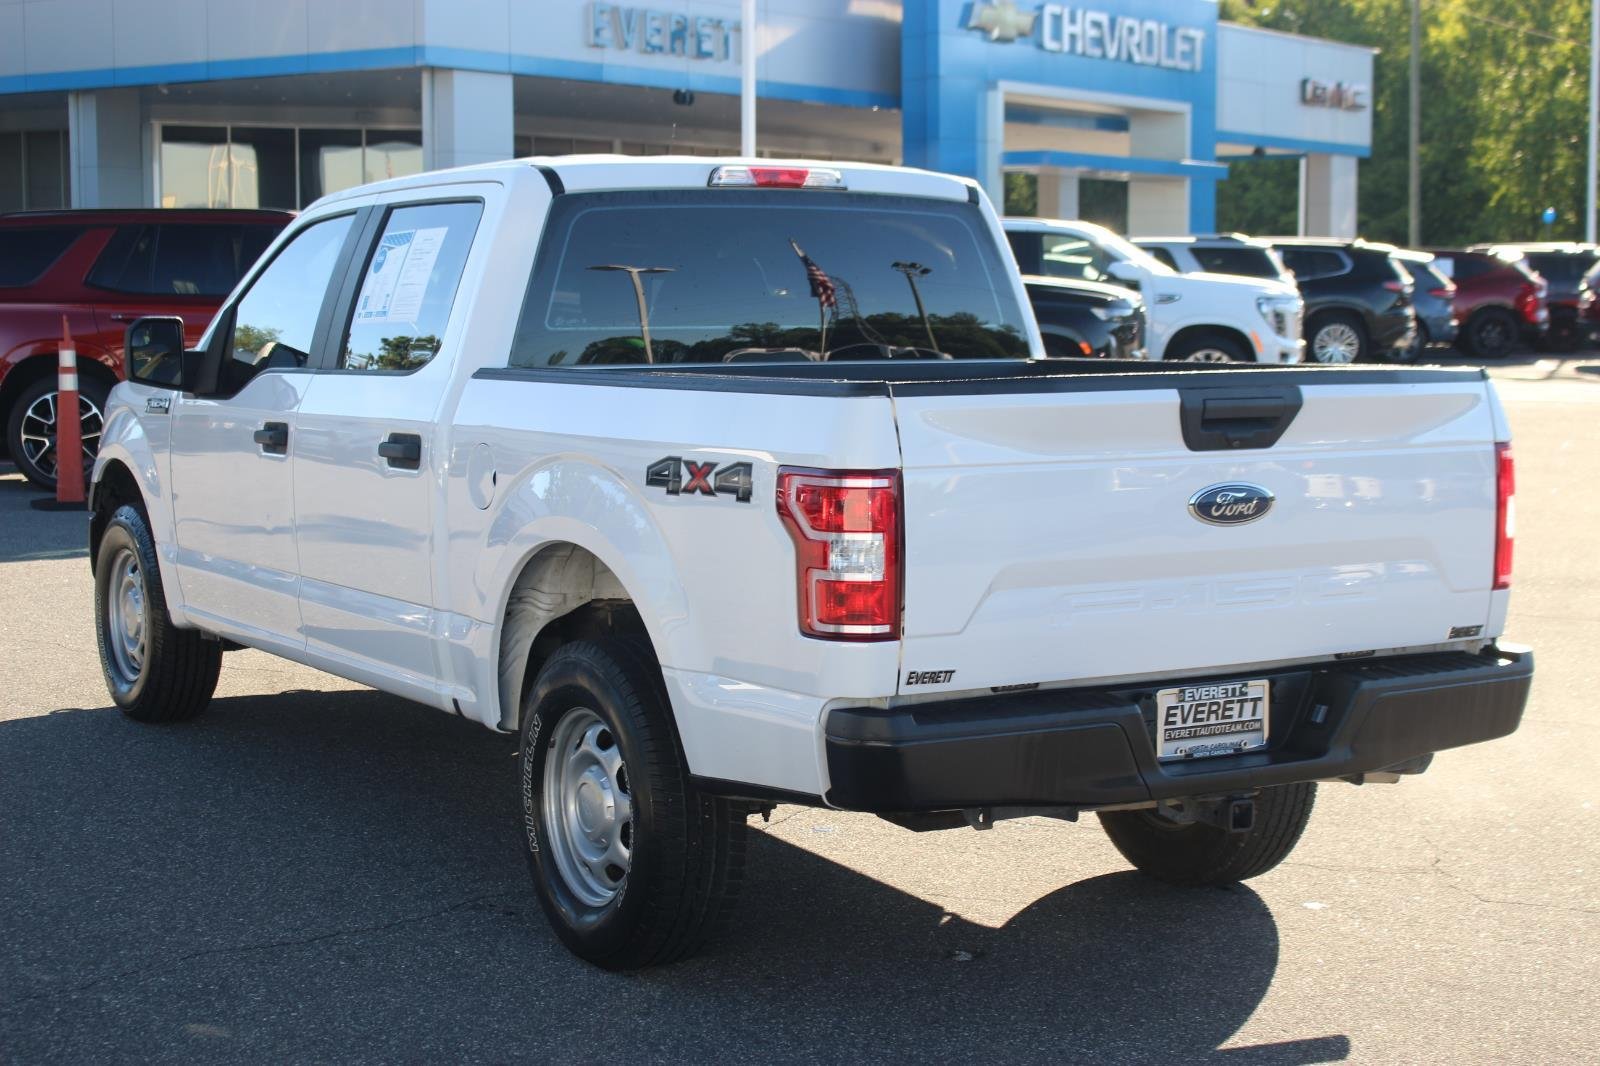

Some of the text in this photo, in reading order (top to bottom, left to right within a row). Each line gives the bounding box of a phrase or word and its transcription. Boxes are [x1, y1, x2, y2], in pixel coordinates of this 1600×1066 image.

[1042, 5, 1205, 72] CHEVROLET
[1211, 491, 1259, 517] Ford
[906, 669, 956, 685] EVERETT
[1184, 684, 1242, 701] EVERETT
[1164, 697, 1262, 726] EVERETT
[1165, 721, 1261, 740] EVERETTAUTOTEAM.COM
[523, 712, 542, 852] MICHELIN
